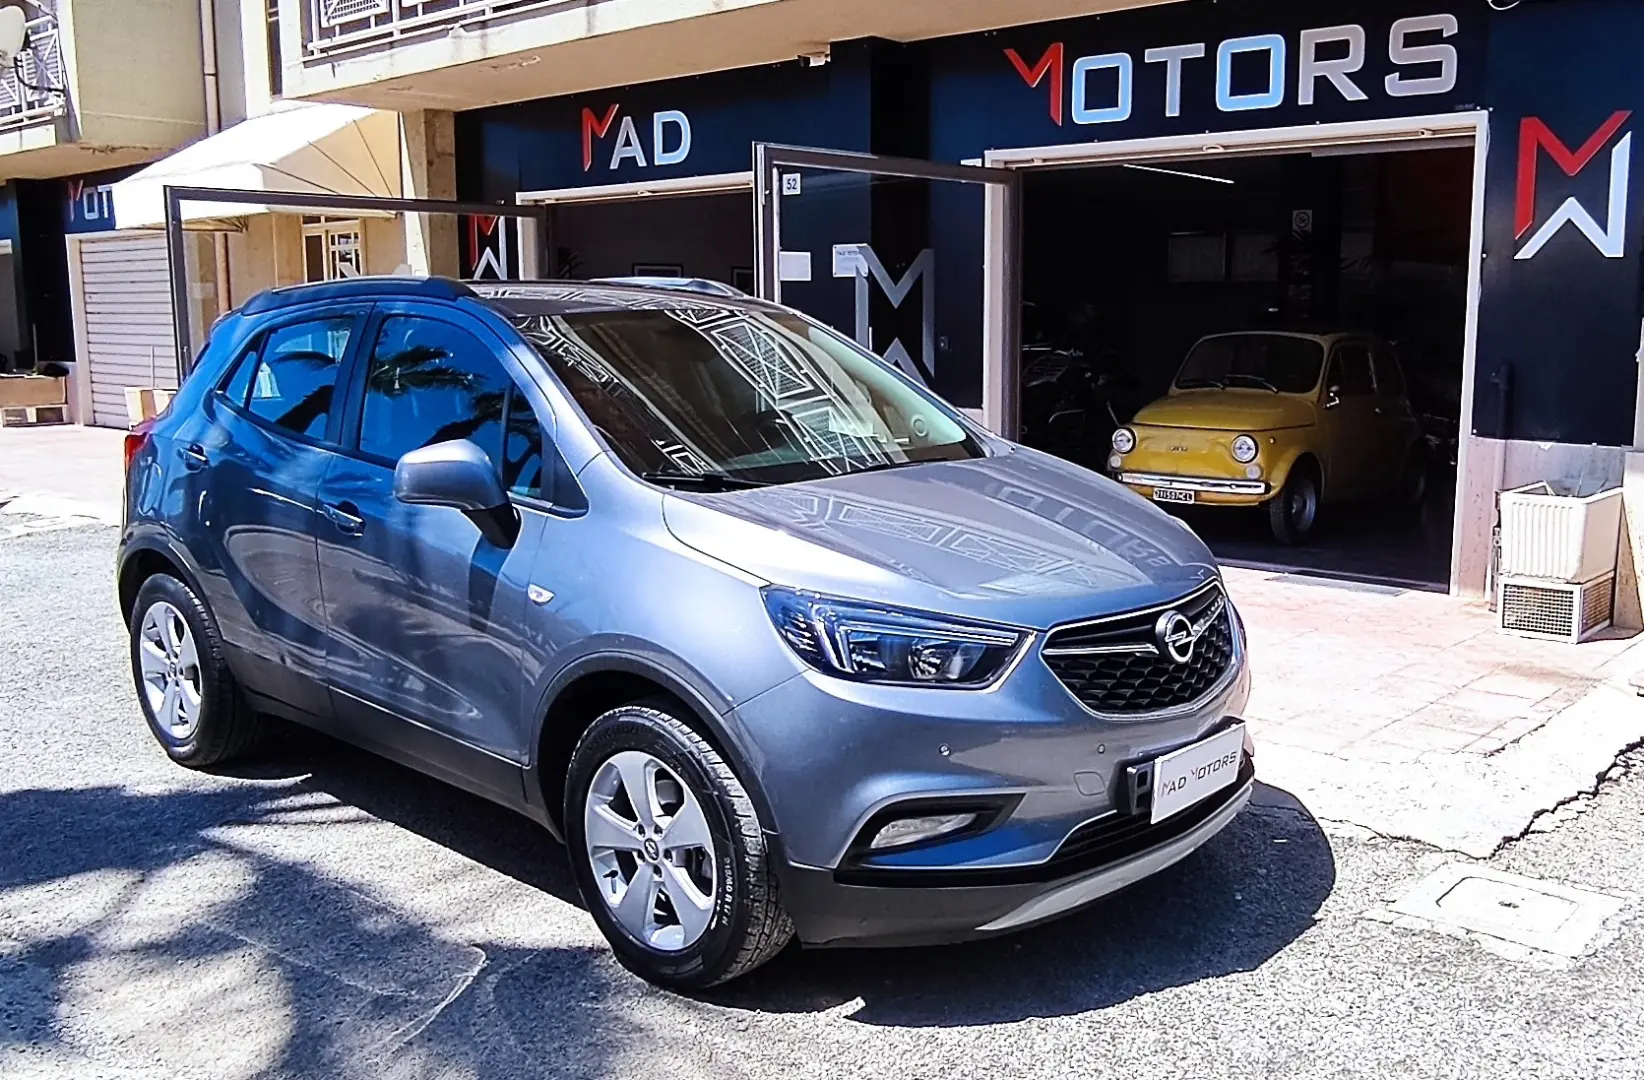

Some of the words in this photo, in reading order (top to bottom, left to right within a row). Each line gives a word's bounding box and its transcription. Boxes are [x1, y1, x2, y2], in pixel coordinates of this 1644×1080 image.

[1002, 13, 1459, 127] MOTORS
[581, 103, 692, 172] MAD
[786, 178, 798, 191] 52
[1161, 776, 1187, 798] MAD
[1190, 751, 1238, 781] MOTORS
